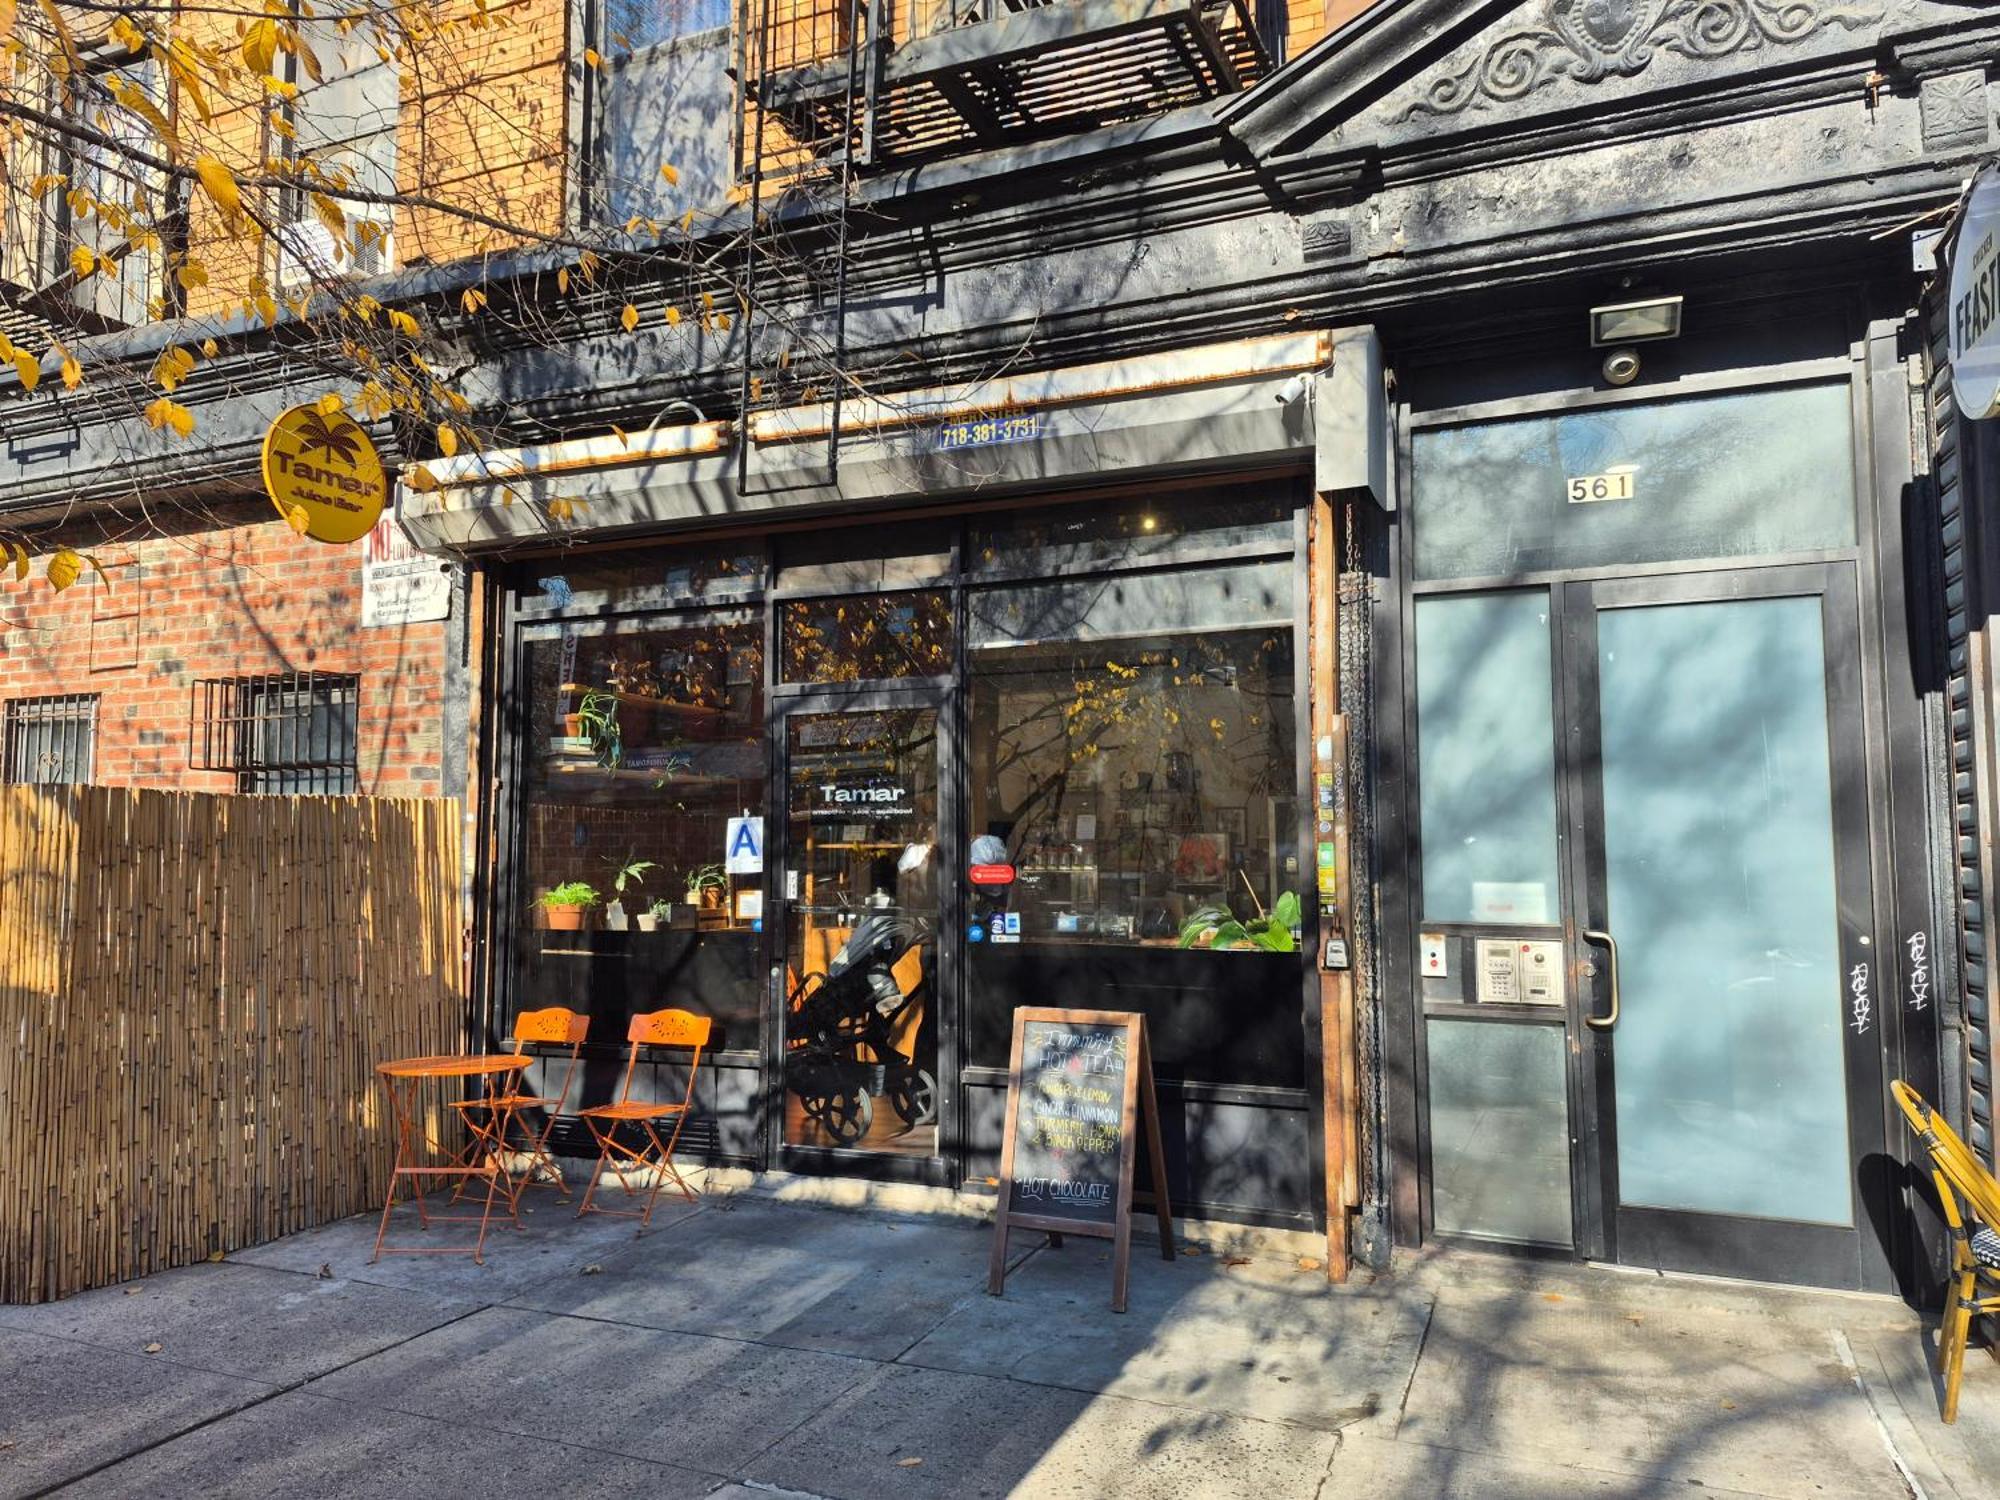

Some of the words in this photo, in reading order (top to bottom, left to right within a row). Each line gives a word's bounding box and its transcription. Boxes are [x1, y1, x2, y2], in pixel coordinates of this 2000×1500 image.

[943, 417, 1037, 447] 718-381-3731
[273, 449, 380, 497] Tamar
[291, 486, 333, 506] Juice
[334, 497, 363, 513] Bar
[1572, 475, 1625, 500] 561
[820, 785, 906, 802] Tamar
[732, 824, 758, 857] A
[1039, 1051, 1067, 1070] HOT
[1081, 1053, 1114, 1073] TEA
[1022, 1177, 1048, 1195] HOT
[1049, 1179, 1110, 1200] CHOCOLATE
